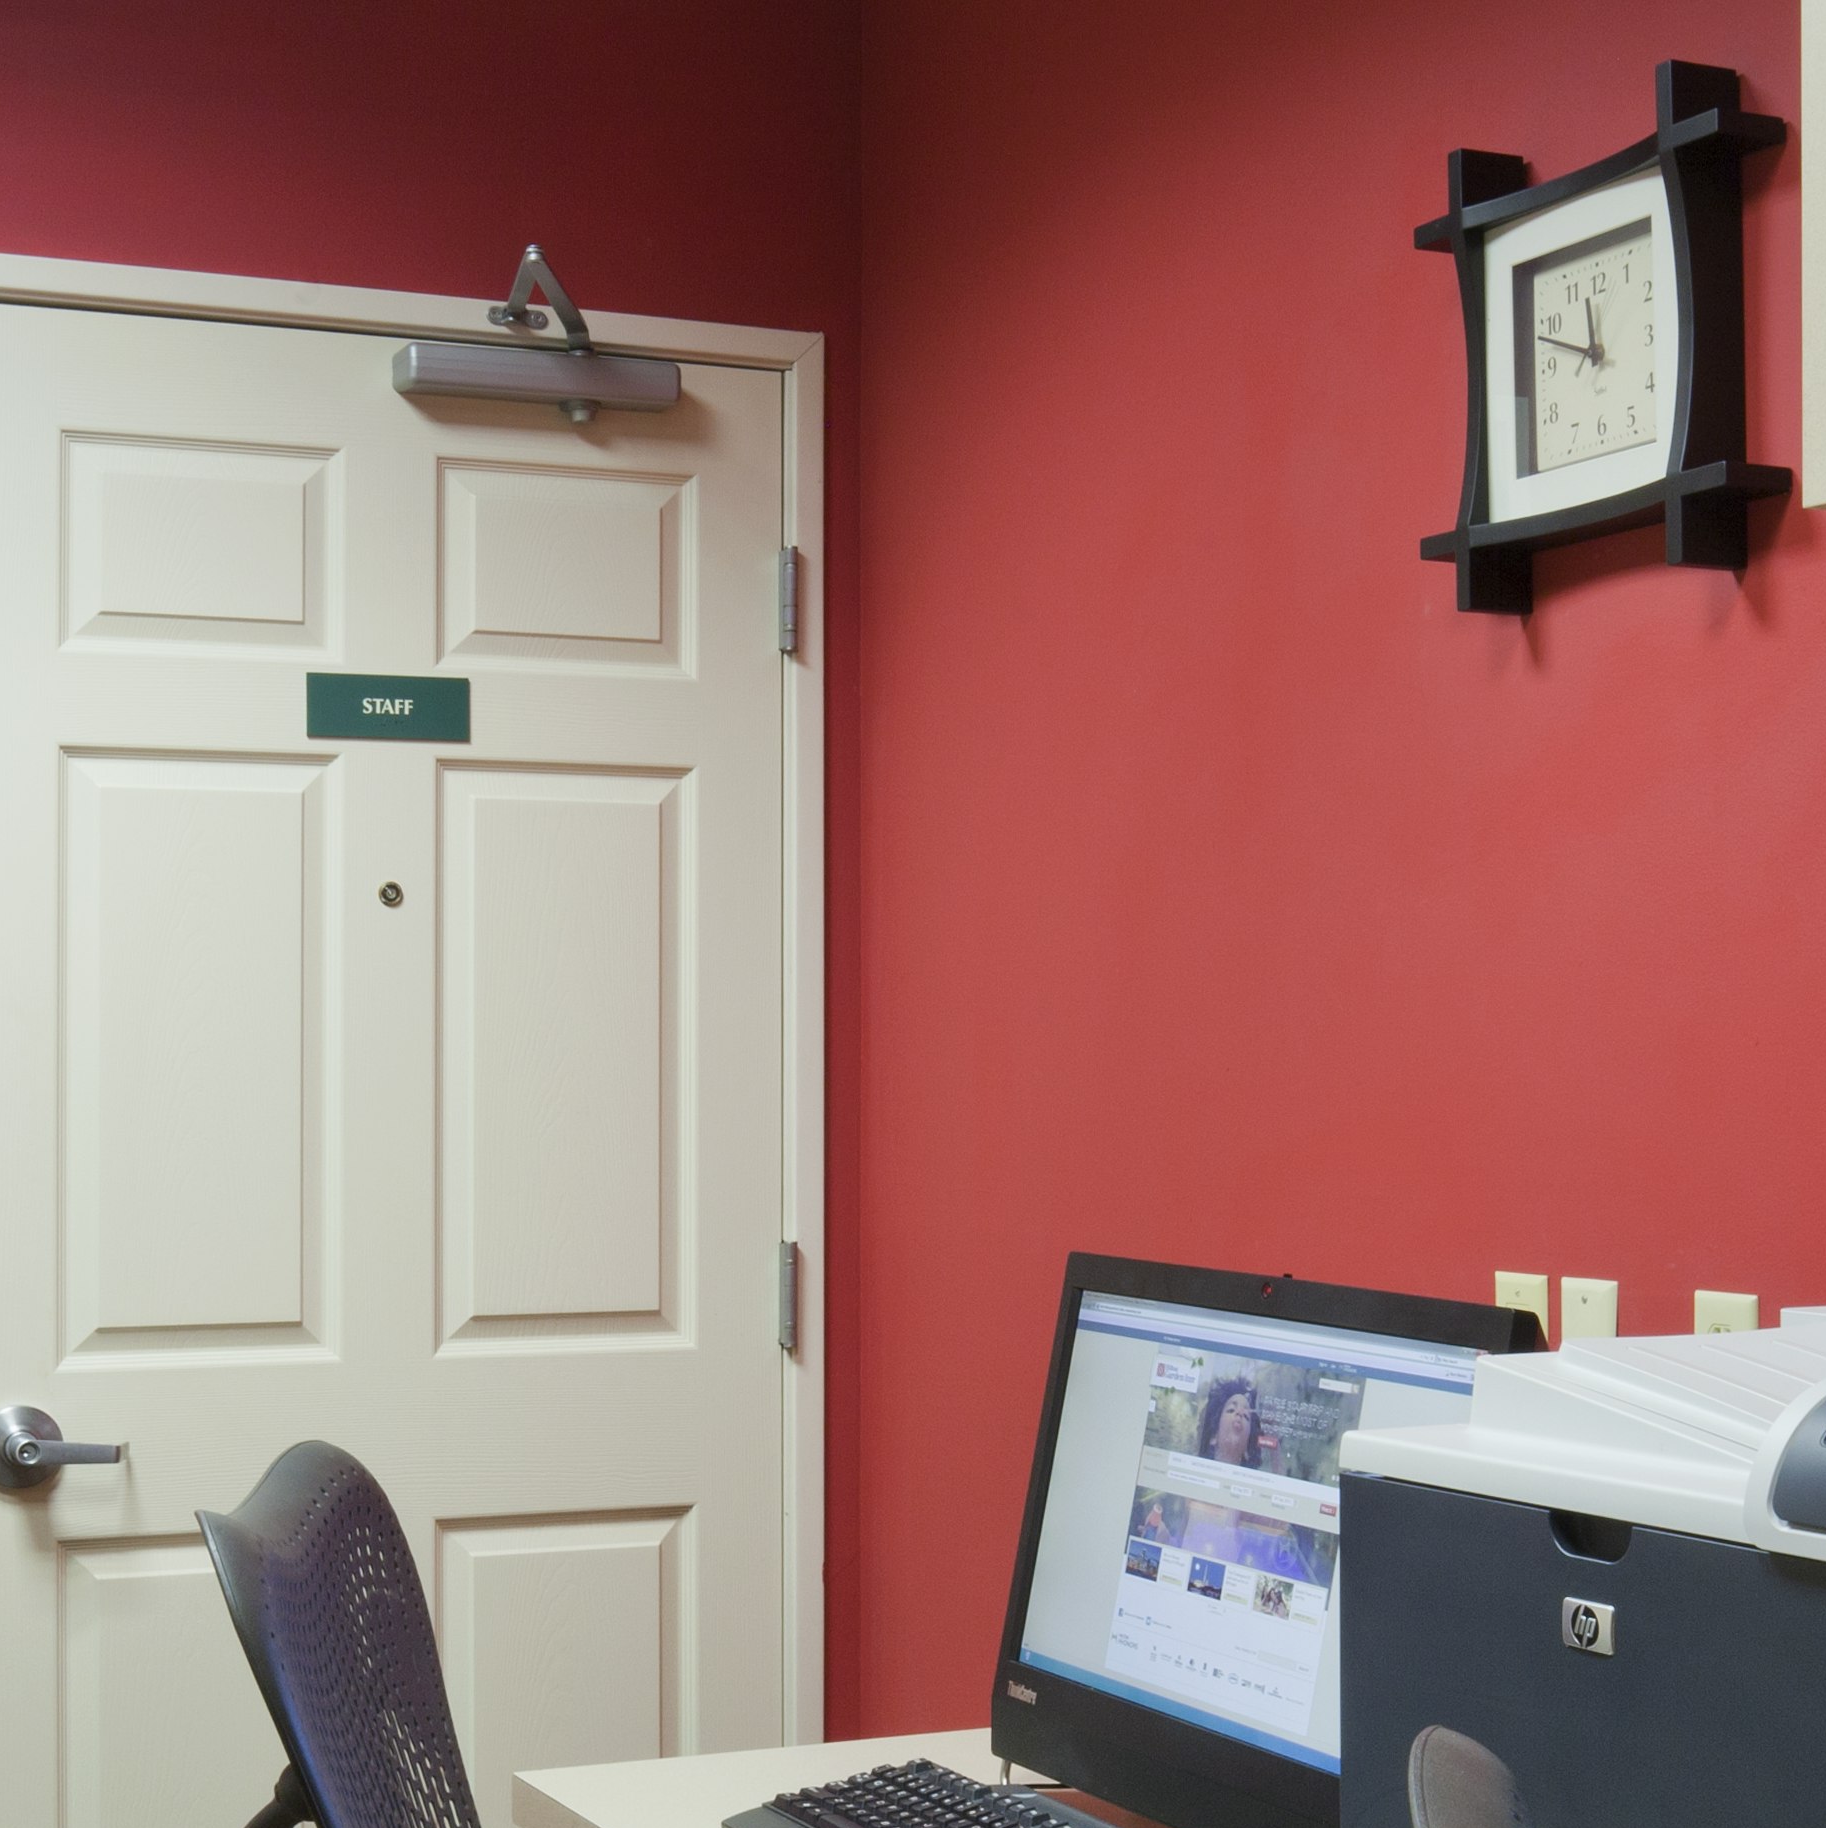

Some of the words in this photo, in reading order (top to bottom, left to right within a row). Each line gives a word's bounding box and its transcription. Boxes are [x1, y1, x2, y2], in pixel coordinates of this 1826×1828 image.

[1590, 271, 1606, 297] 12
[1622, 263, 1630, 284] 1
[1565, 281, 1579, 305] 11
[1643, 280, 1652, 303] 2
[1545, 312, 1562, 336] 10
[1644, 324, 1654, 347] 3
[1547, 356, 1557, 379] 9
[1644, 372, 1655, 393] 4
[1548, 402, 1559, 424] 8
[1626, 406, 1636, 429] 5
[1570, 422, 1580, 444] 7
[1597, 415, 1607, 436] 6
[362, 697, 414, 716] STAFF
[1574, 1603, 1597, 1648] hp
